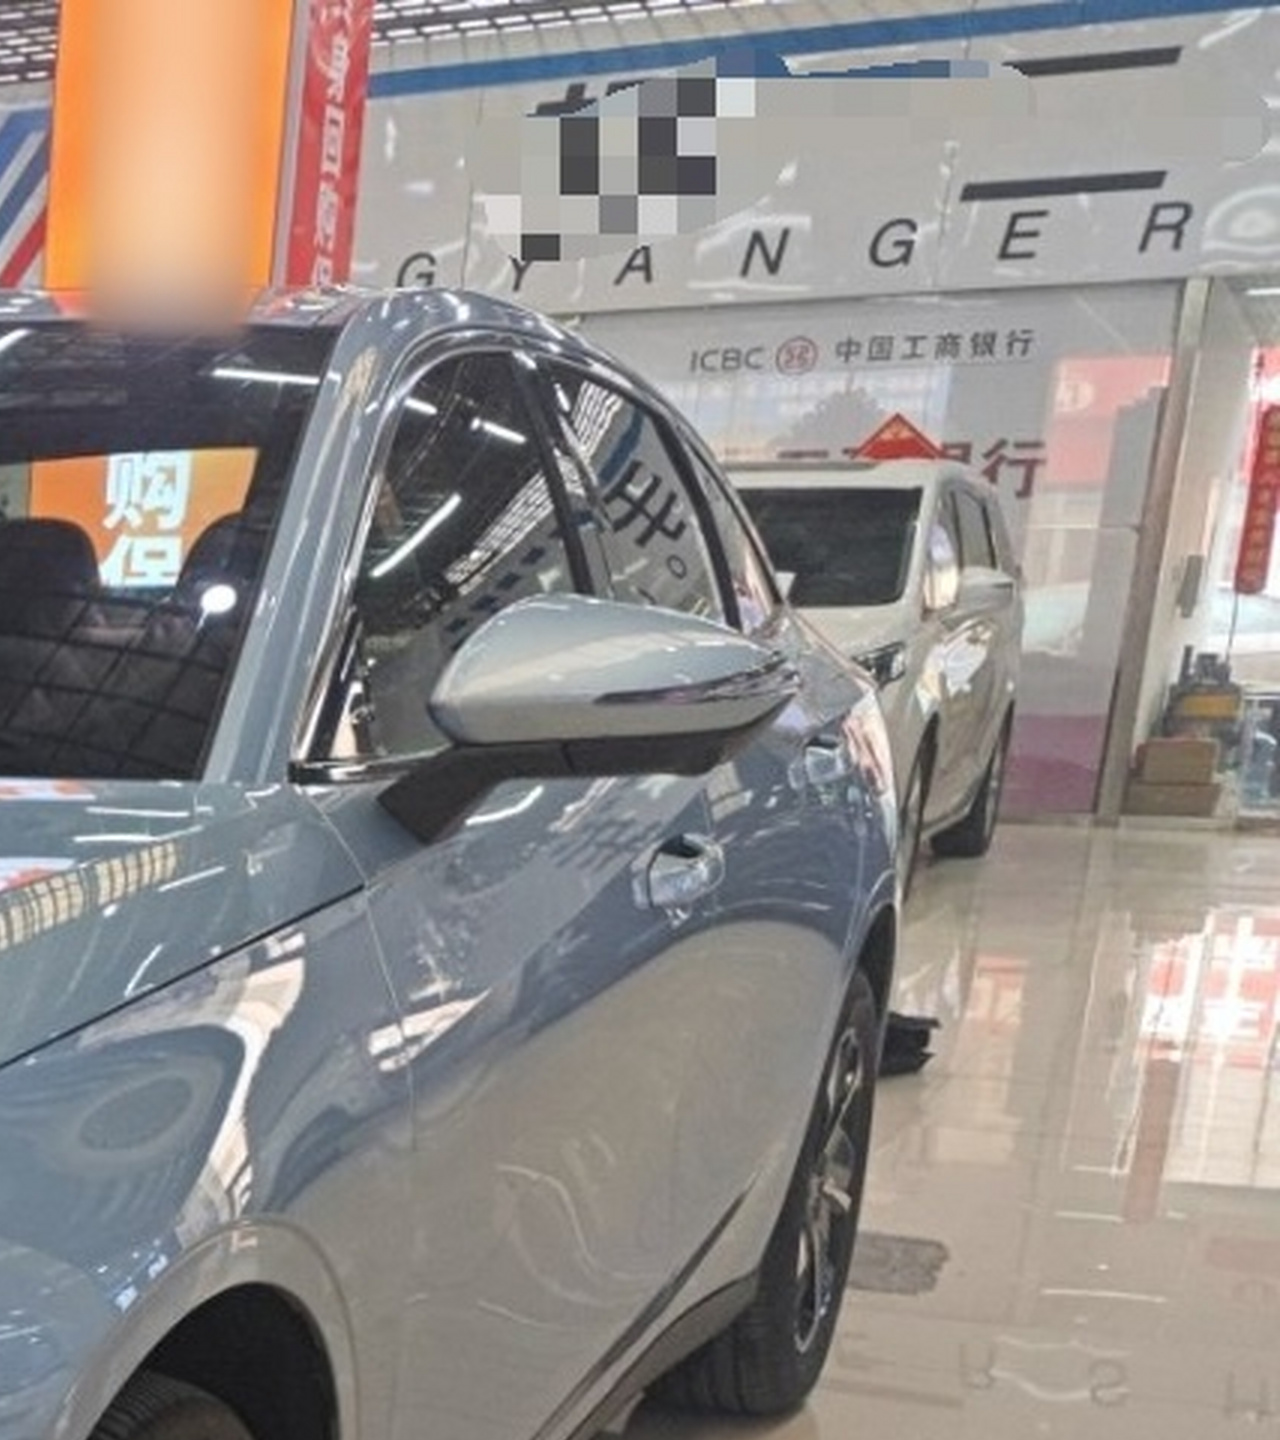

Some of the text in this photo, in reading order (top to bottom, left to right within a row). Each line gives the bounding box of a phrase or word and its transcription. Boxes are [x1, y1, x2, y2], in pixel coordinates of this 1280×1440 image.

[690, 347, 764, 373] ICBC
[834, 329, 1035, 363] 中国工商银行
